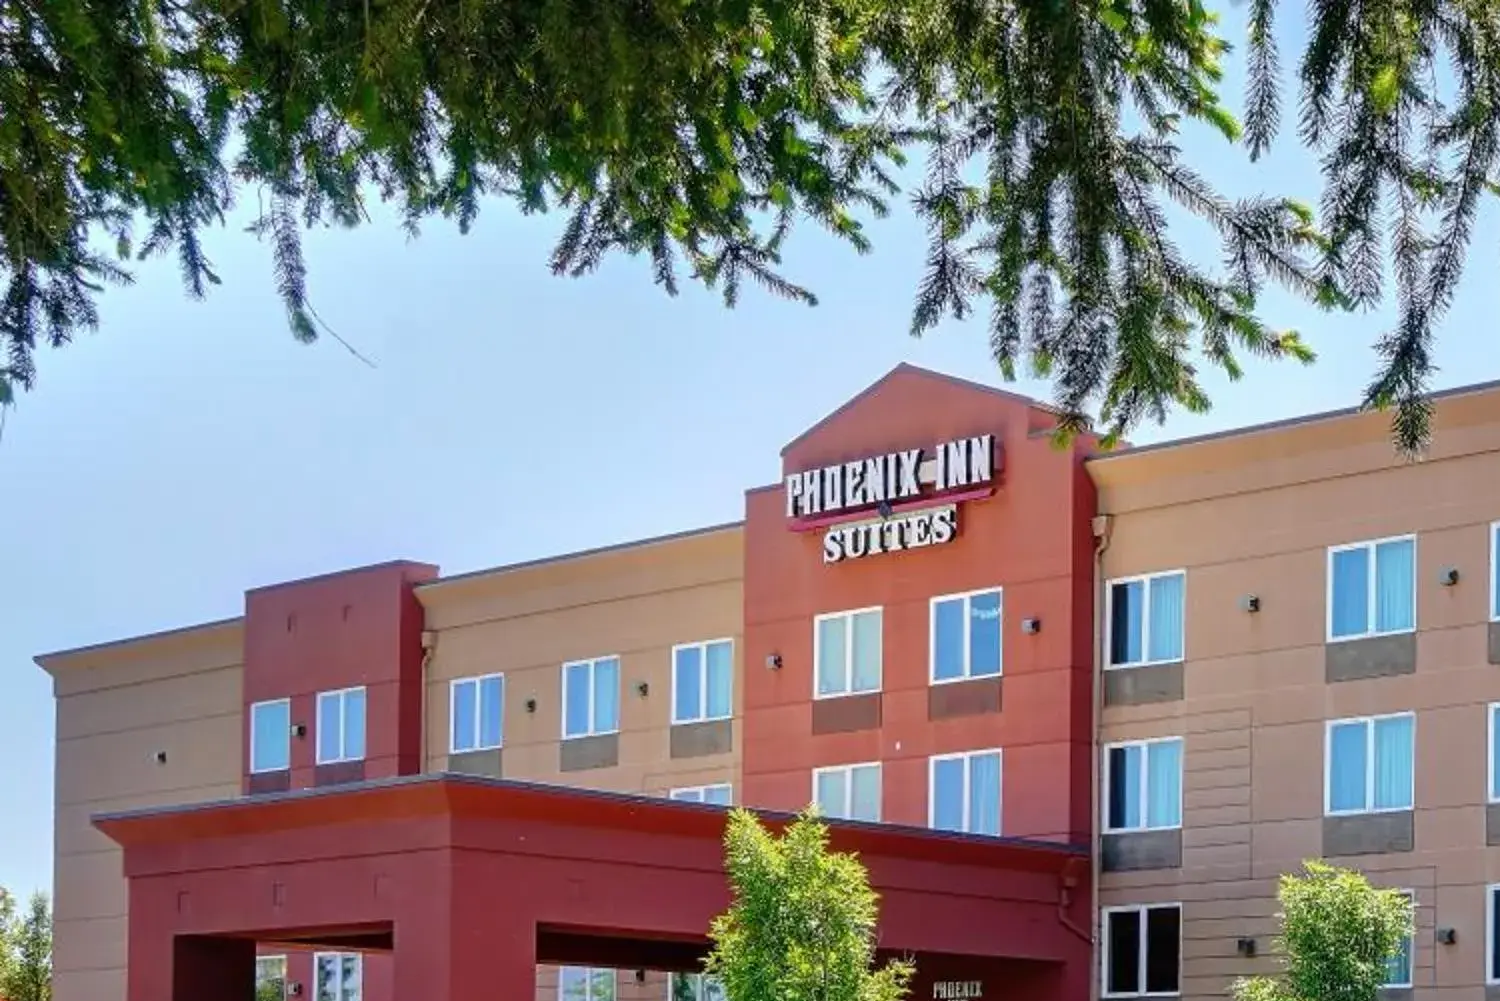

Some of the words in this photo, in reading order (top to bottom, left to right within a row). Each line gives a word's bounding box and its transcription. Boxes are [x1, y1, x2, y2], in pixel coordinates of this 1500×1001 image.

[786, 449, 922, 518] PHOENIX
[935, 434, 993, 491] INN
[823, 509, 956, 564] SUITES
[933, 981, 982, 999] PHOENIX
